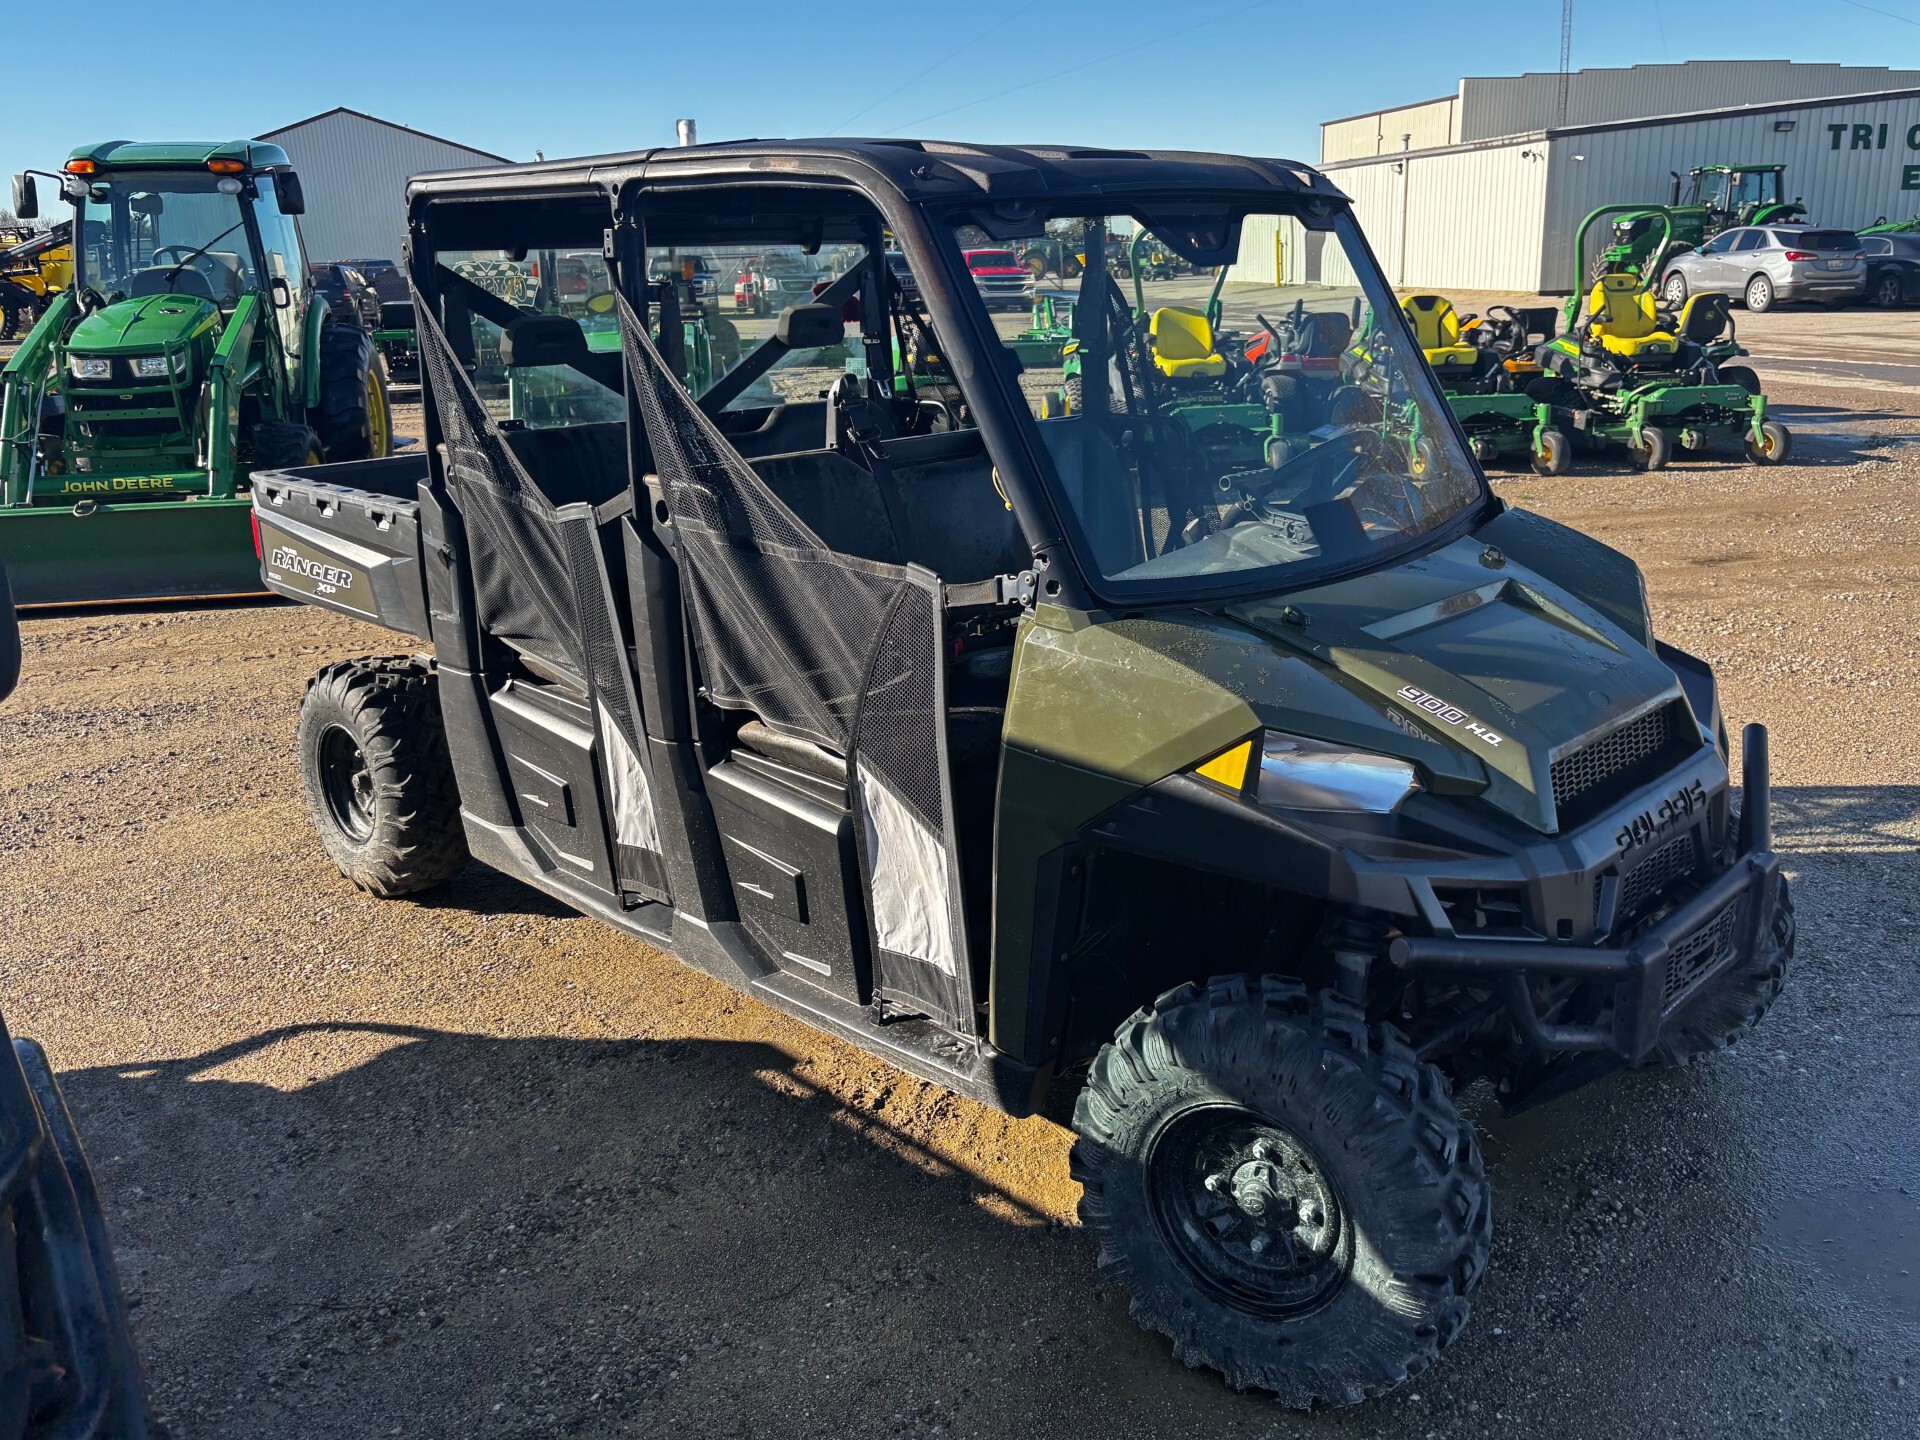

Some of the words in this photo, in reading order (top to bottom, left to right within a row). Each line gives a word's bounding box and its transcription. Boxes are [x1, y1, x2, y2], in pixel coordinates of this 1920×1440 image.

[1827, 123, 1888, 151] TRI
[60, 480, 110, 493] JOHN
[112, 477, 174, 491] DEERE
[271, 549, 353, 588] RANGER
[317, 582, 337, 594] XP
[1396, 685, 1469, 725] 900
[1615, 778, 1706, 861] POLARIS
